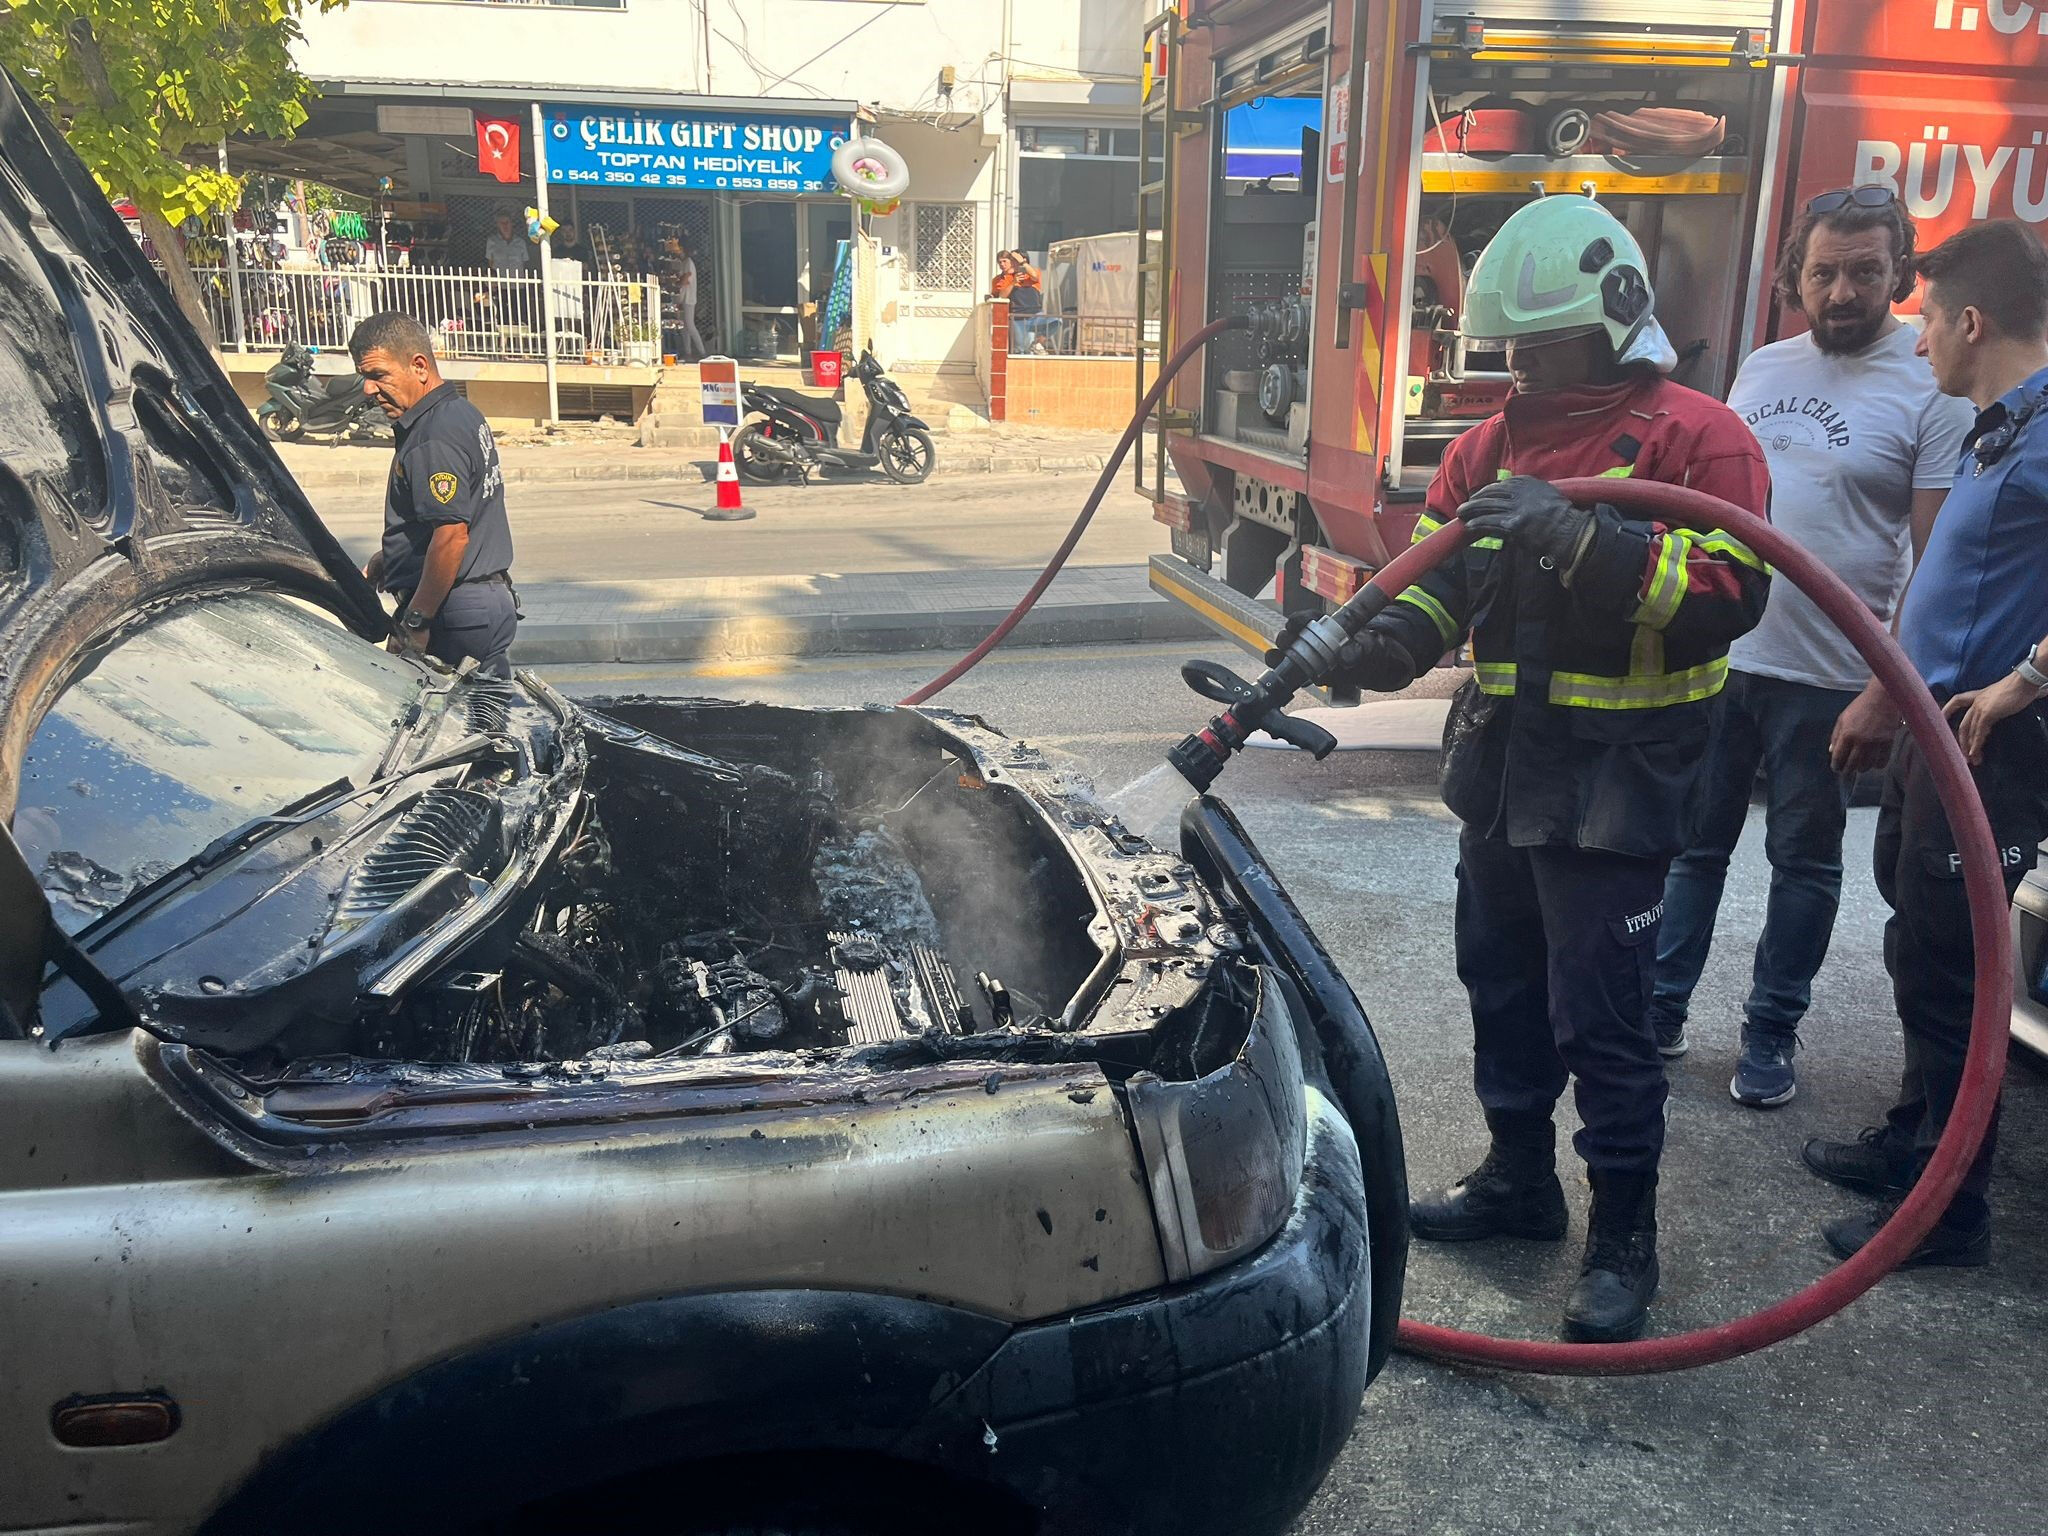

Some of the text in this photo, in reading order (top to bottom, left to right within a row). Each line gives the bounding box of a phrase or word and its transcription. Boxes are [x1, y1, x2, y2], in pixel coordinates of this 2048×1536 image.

[580, 110, 823, 153] ÇELİK GIFT SHOP
[551, 168, 564, 180] 0
[568, 169, 600, 181] 544
[604, 171, 635, 183] 350
[640, 173, 661, 184] 42
[665, 174, 687, 185] 35
[715, 176, 728, 187] 0
[731, 177, 763, 188] 553
[767, 179, 799, 190] 859
[803, 180, 823, 191] 30
[828, 181, 840, 191] 7
[596, 151, 803, 175] TOPTAN HEDİYELİK
[1853, 125, 2048, 223] BÜYÜ
[1746, 396, 1798, 426] OCAL
[1801, 397, 1850, 450] CHAMP.
